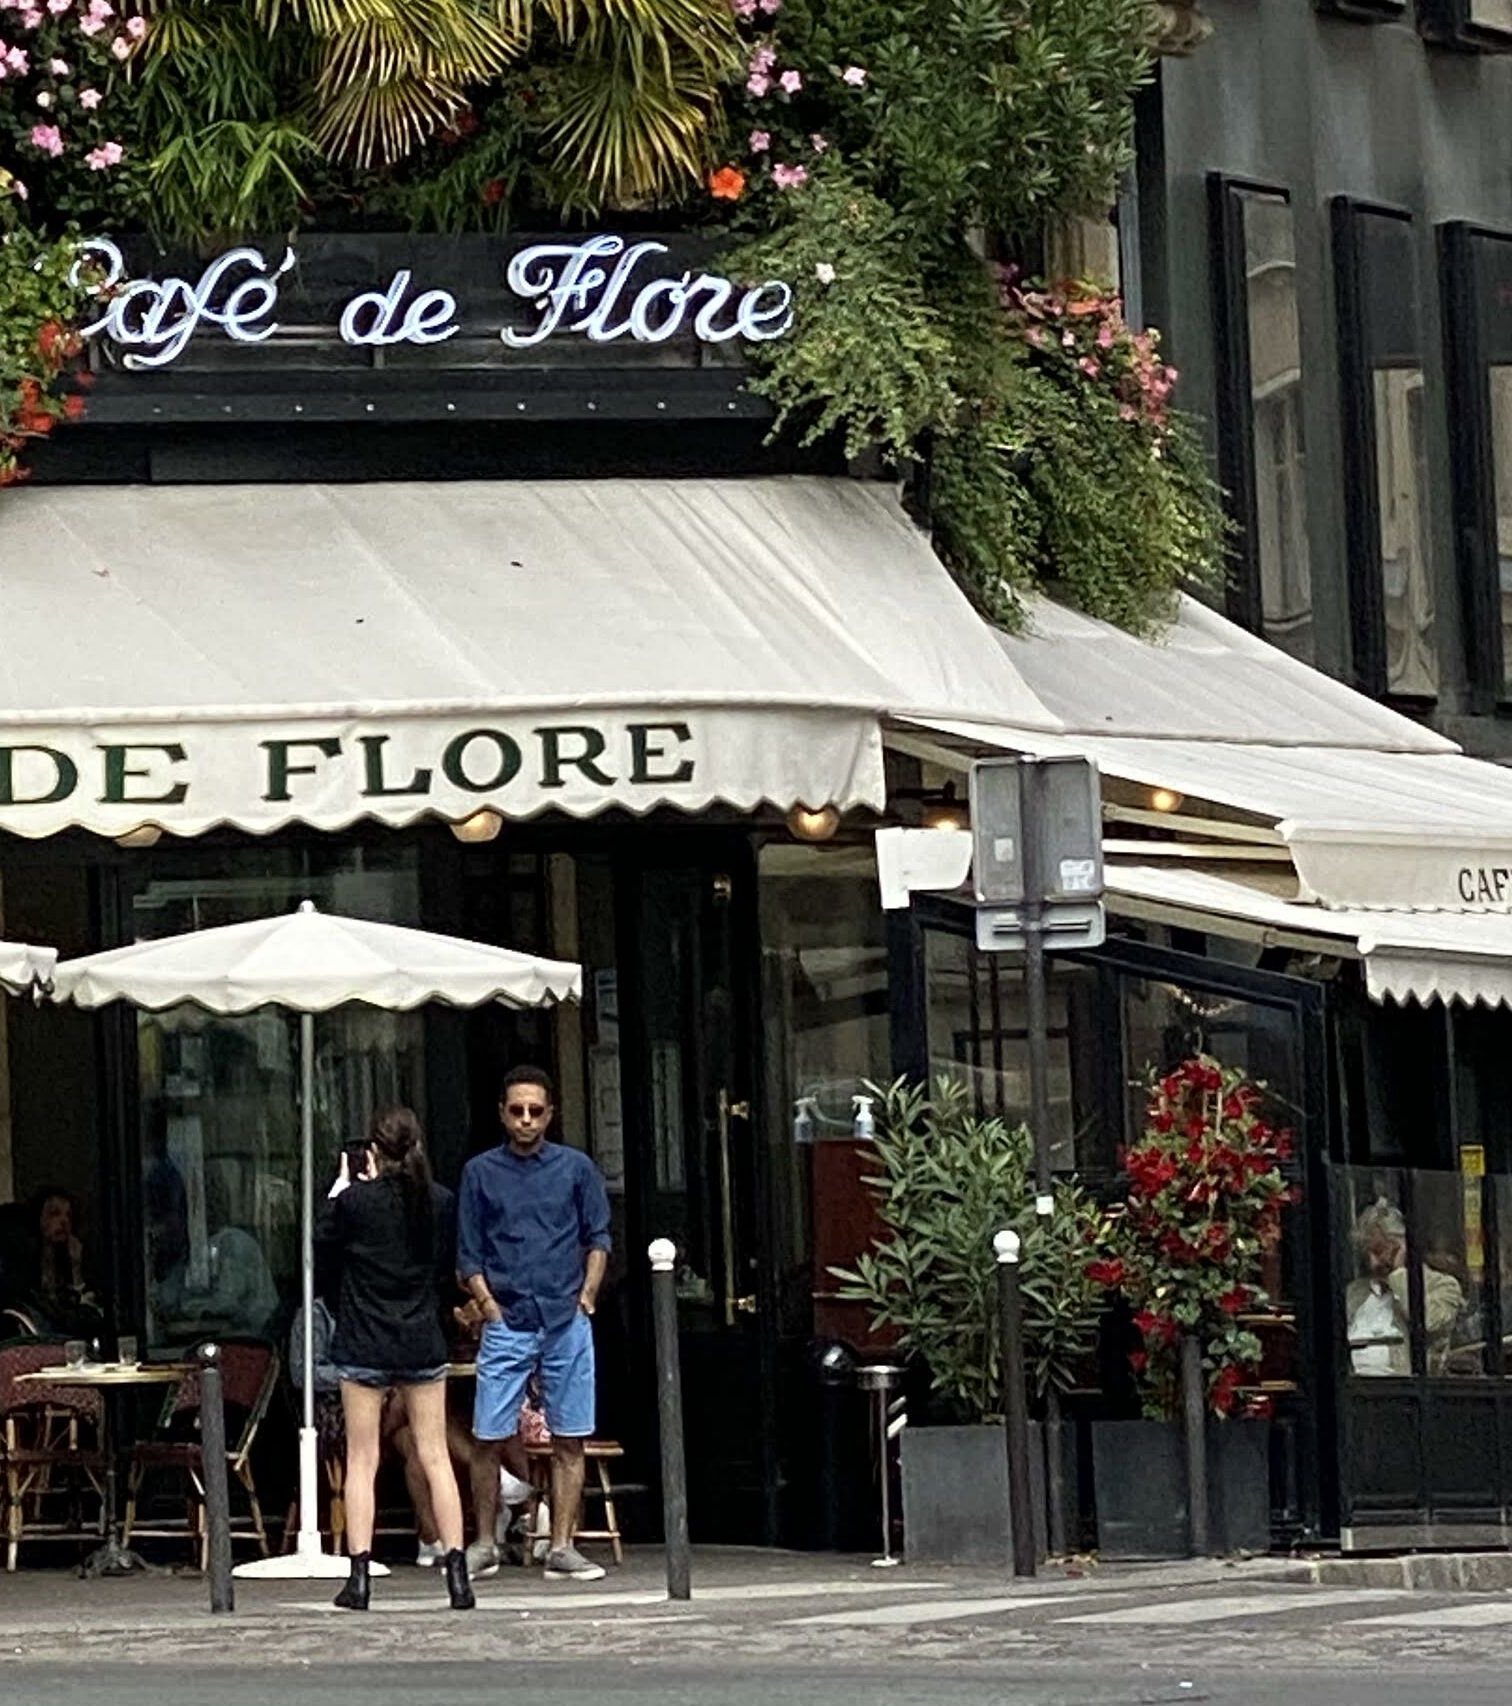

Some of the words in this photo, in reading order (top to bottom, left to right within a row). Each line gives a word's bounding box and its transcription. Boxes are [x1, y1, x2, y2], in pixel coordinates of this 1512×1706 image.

[340, 269, 459, 345] de
[500, 234, 795, 348] Flore
[261, 722, 696, 801] FLORE
[1459, 867, 1512, 902] CAF
